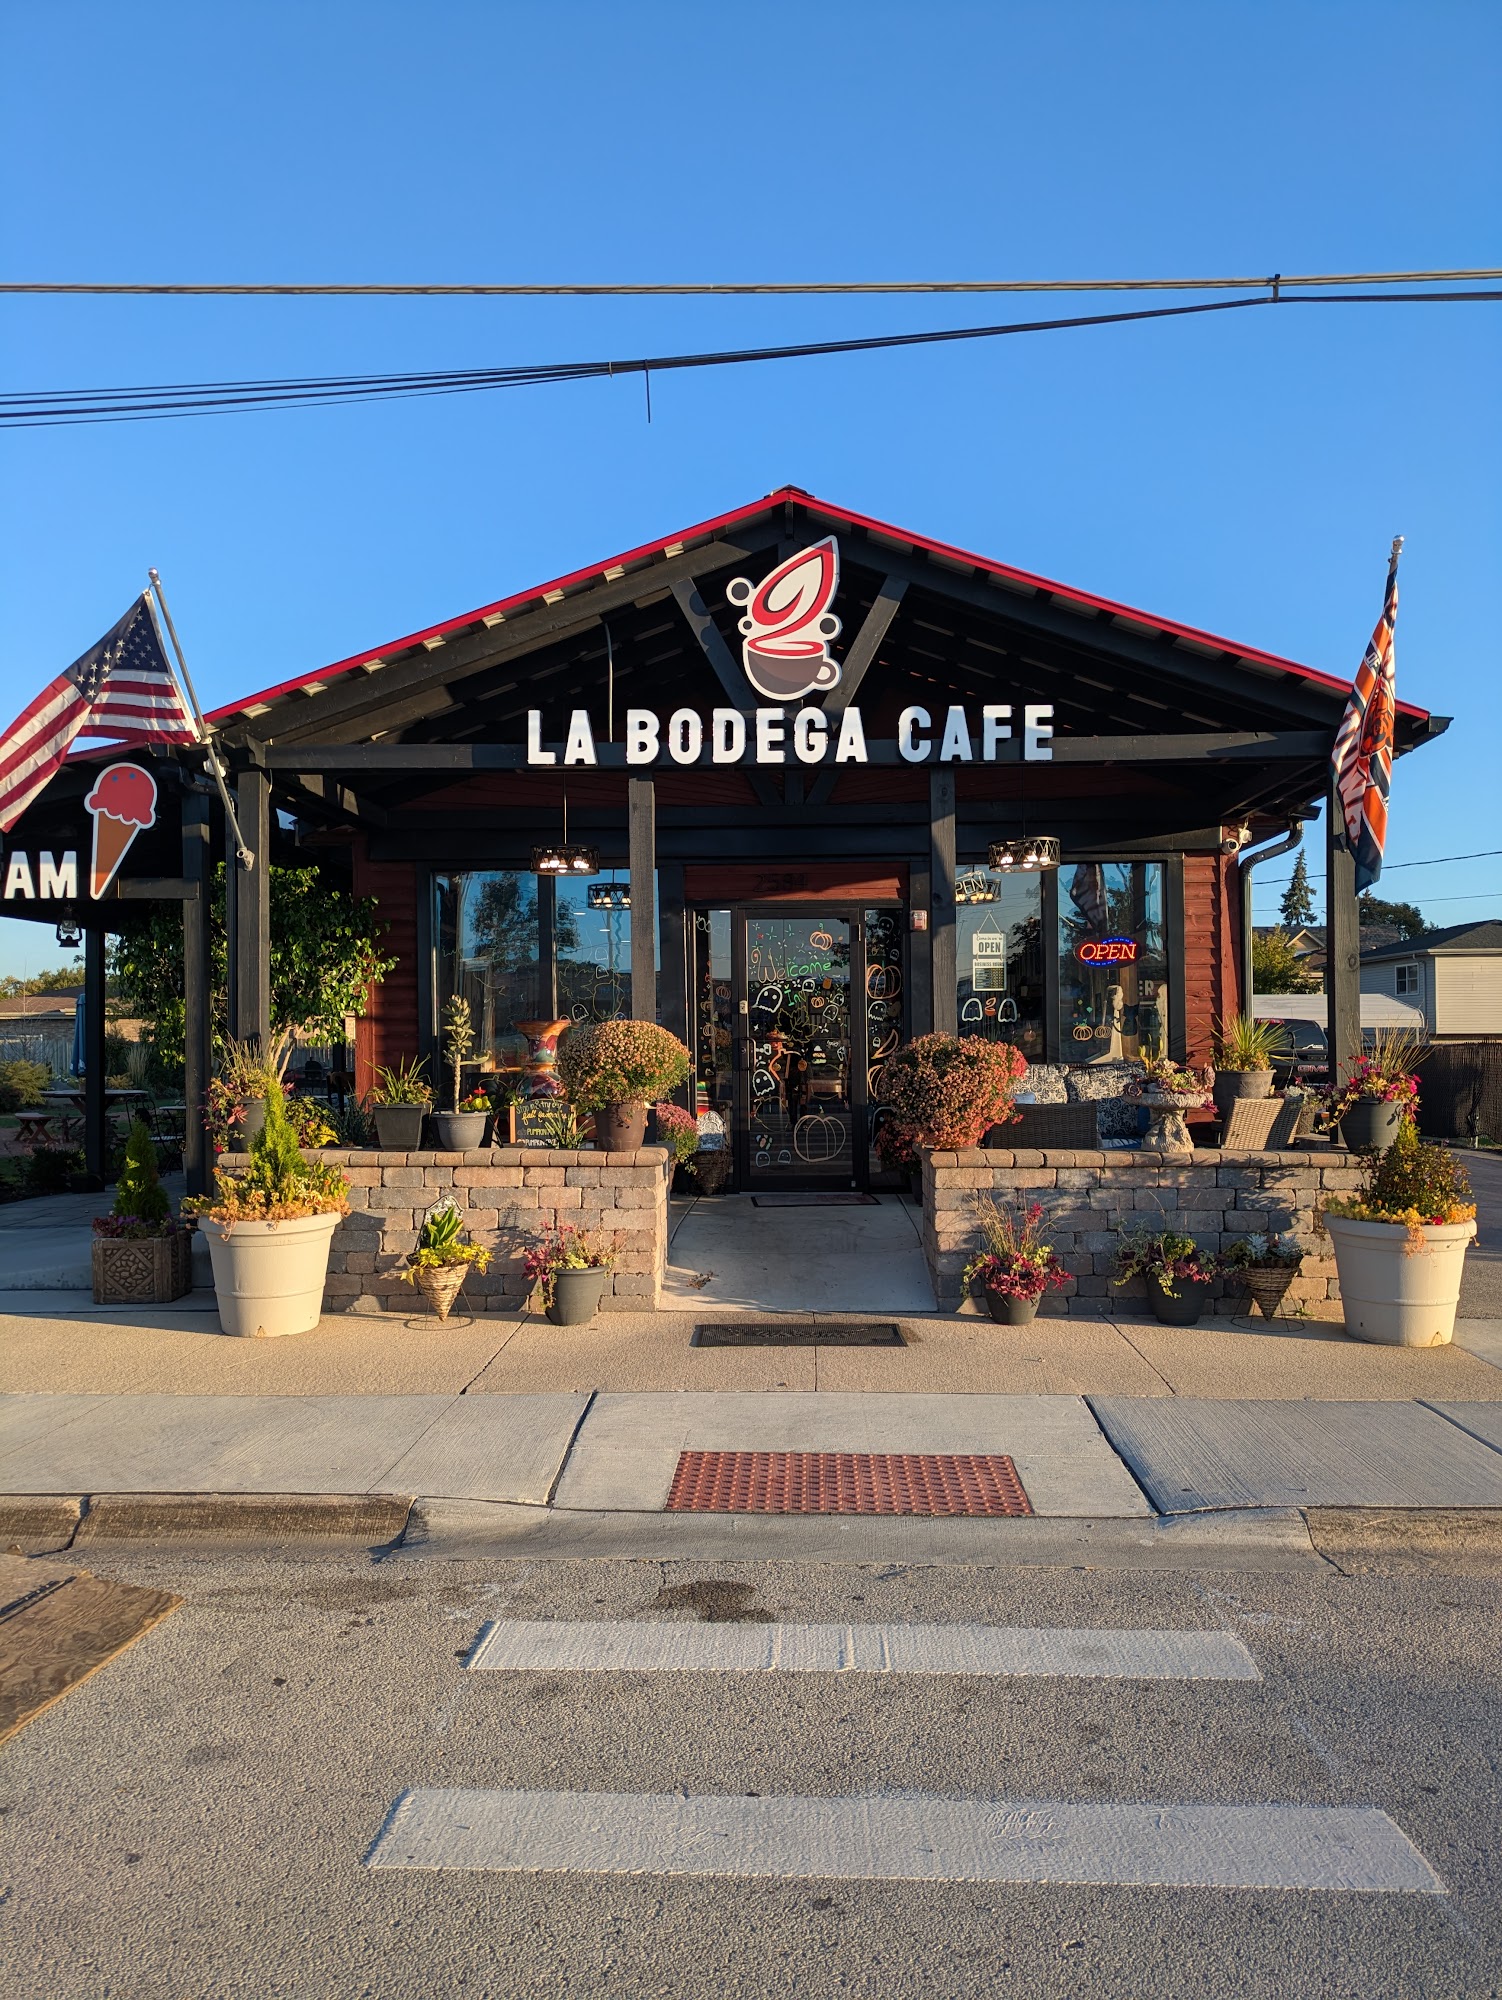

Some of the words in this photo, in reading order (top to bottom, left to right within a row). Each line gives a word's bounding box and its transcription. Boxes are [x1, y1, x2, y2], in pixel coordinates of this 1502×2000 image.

[527, 709, 598, 765] LA
[626, 706, 868, 765] BODEGA
[898, 704, 1054, 763] CAFE
[3, 851, 77, 899] AM
[954, 875, 984, 896] PEN
[978, 942, 1001, 953] OPEN
[1079, 943, 1137, 960] OPEN
[751, 947, 832, 984] Welcome
[1297, 1064, 1330, 1073] GMC
